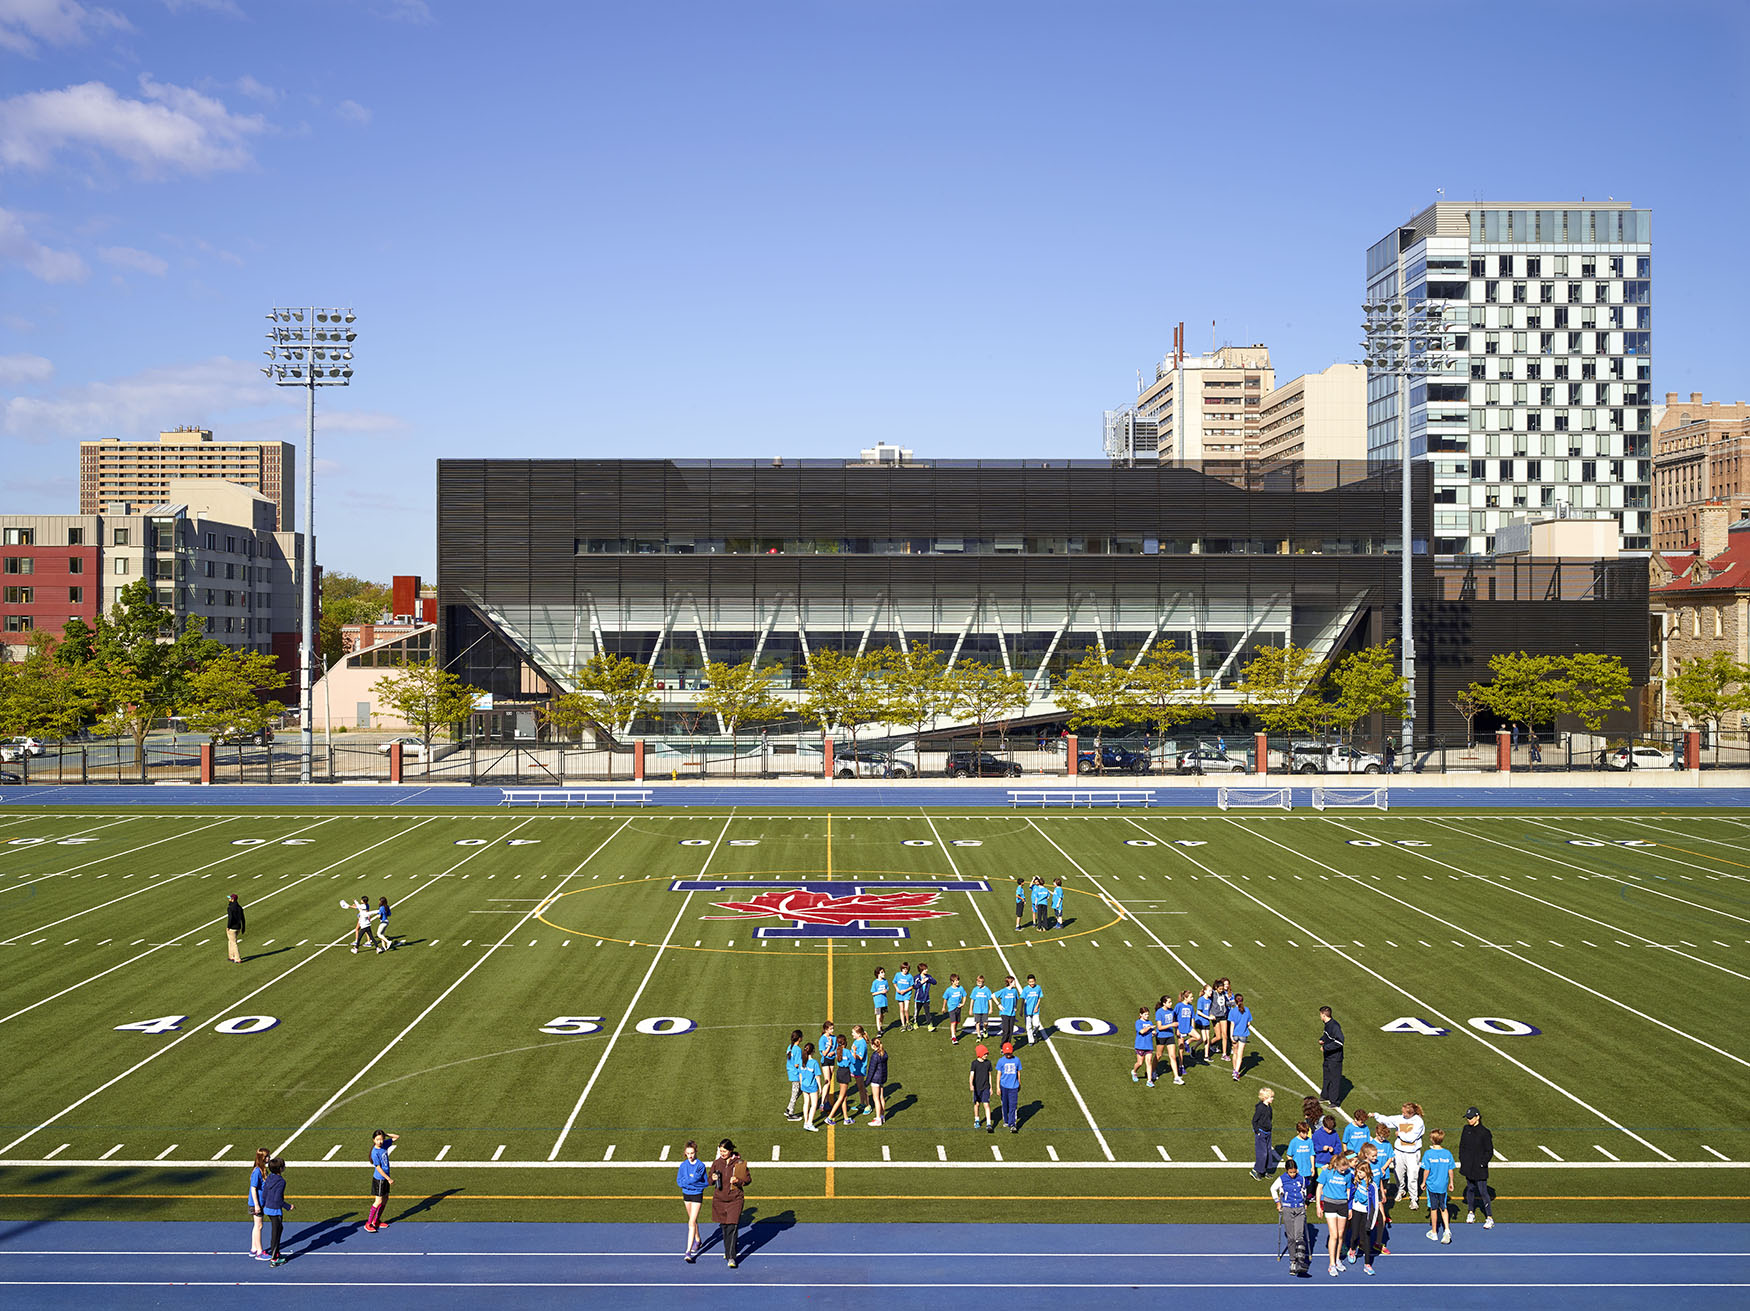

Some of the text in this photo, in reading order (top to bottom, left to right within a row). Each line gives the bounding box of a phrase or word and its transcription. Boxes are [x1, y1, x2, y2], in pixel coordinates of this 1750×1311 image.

[112, 1015, 282, 1034] 40
[538, 1016, 698, 1035] 50
[1379, 1016, 1543, 1036] 40
